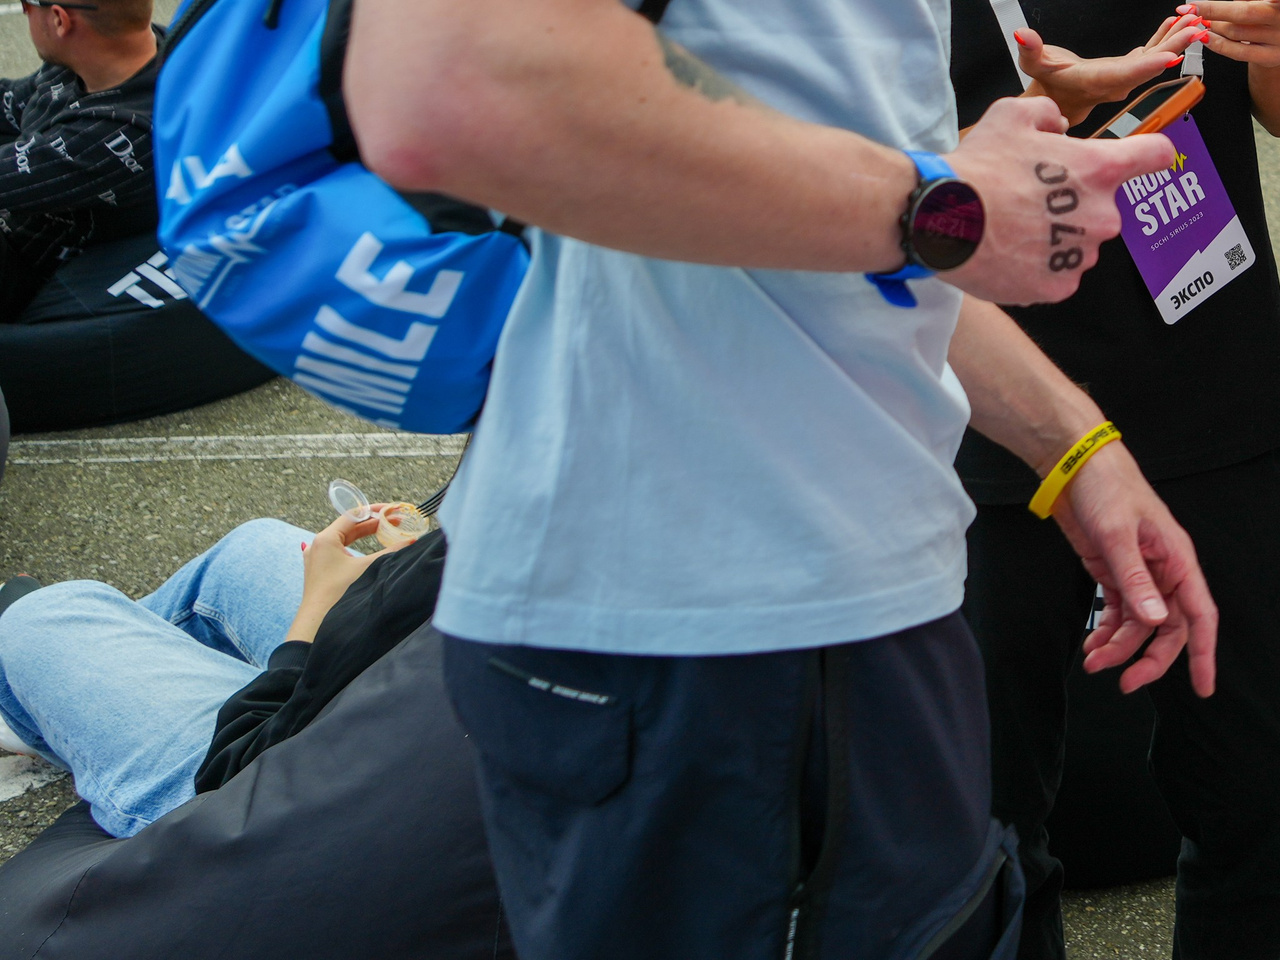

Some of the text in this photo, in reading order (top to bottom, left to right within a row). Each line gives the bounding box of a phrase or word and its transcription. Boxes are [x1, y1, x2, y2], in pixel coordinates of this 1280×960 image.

[104, 129, 145, 174] Dior
[1121, 168, 1172, 206] IRON
[1134, 171, 1206, 236] STAR
[1150, 211, 1205, 252] SOCHI SIRIUS 2023
[1170, 270, 1215, 310] ЭКСПО
